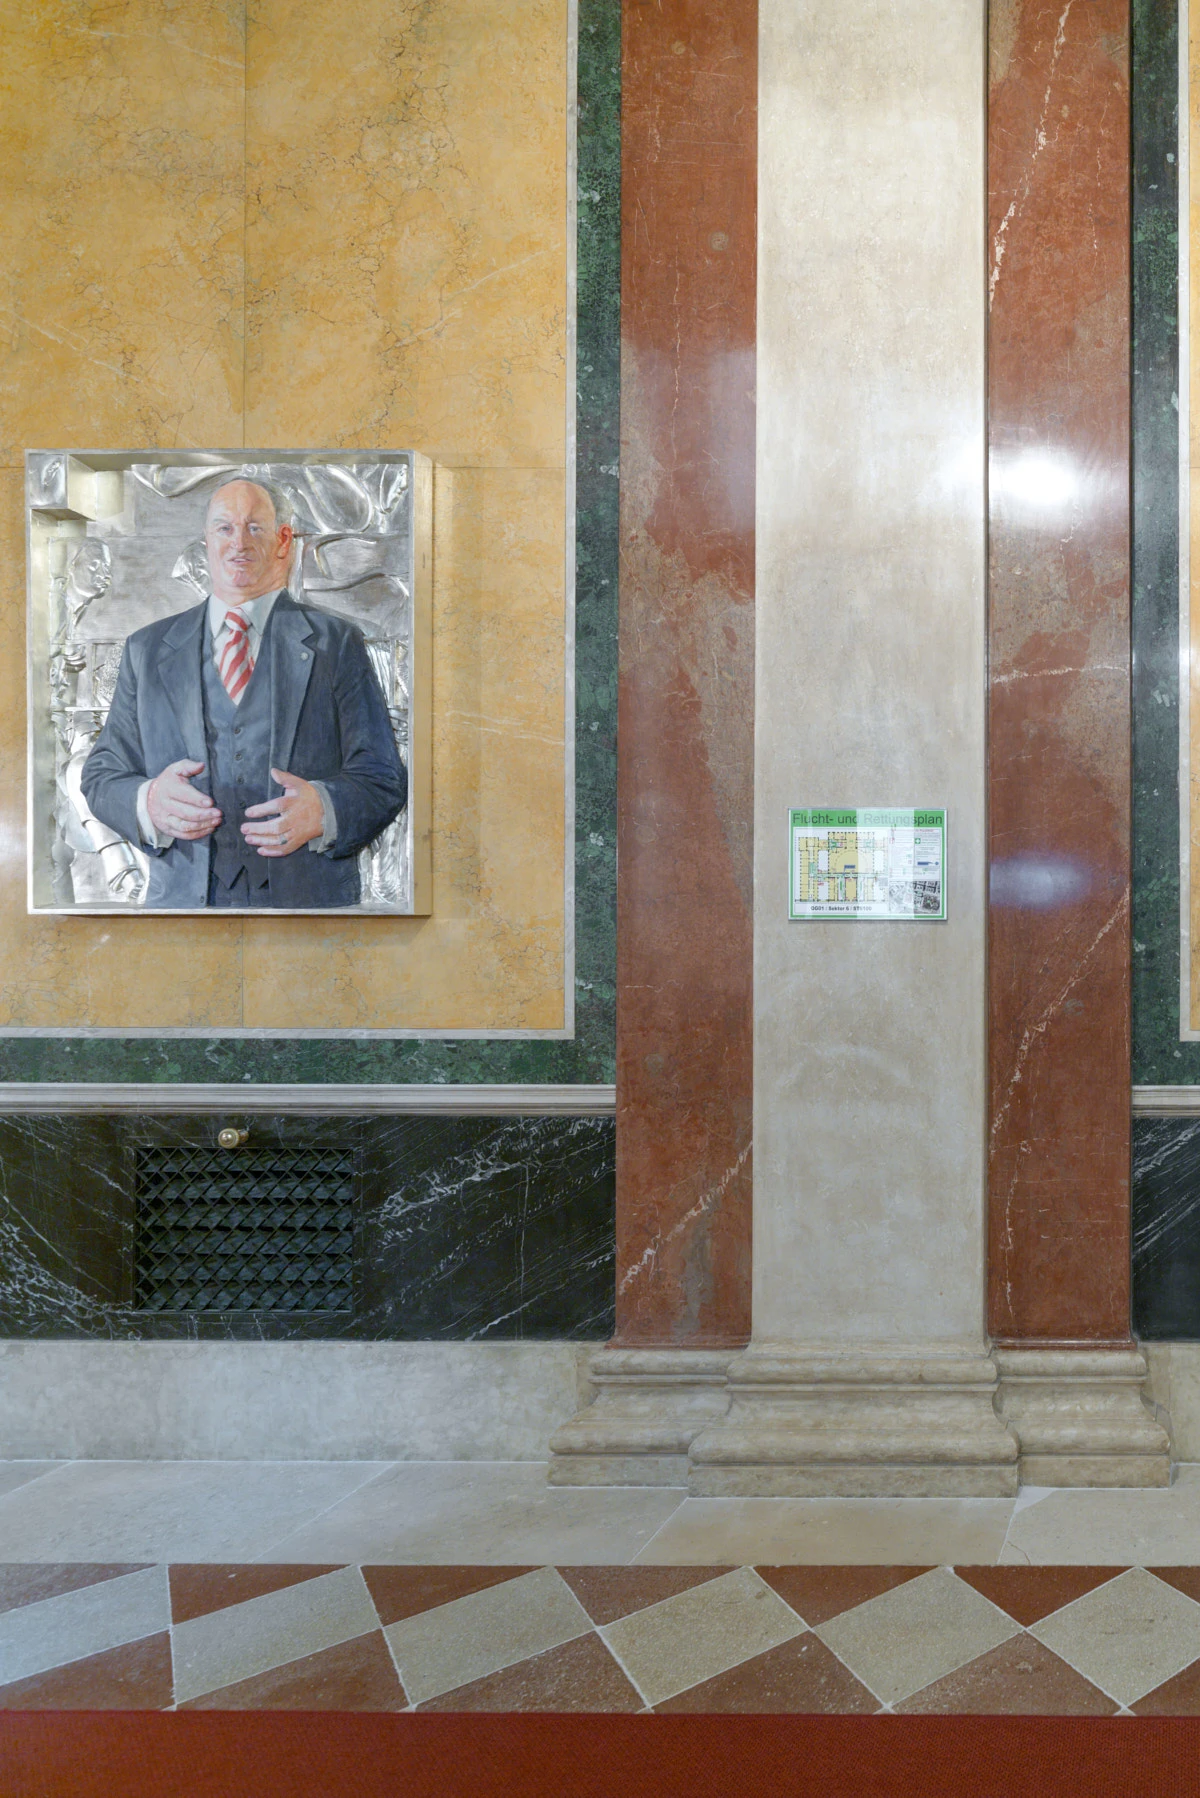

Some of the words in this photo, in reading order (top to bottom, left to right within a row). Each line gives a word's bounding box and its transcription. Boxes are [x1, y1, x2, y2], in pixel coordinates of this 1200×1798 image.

[792, 812, 833, 825] Flucht-
[837, 812, 858, 825] und
[863, 812, 943, 829] Rettungsplan
